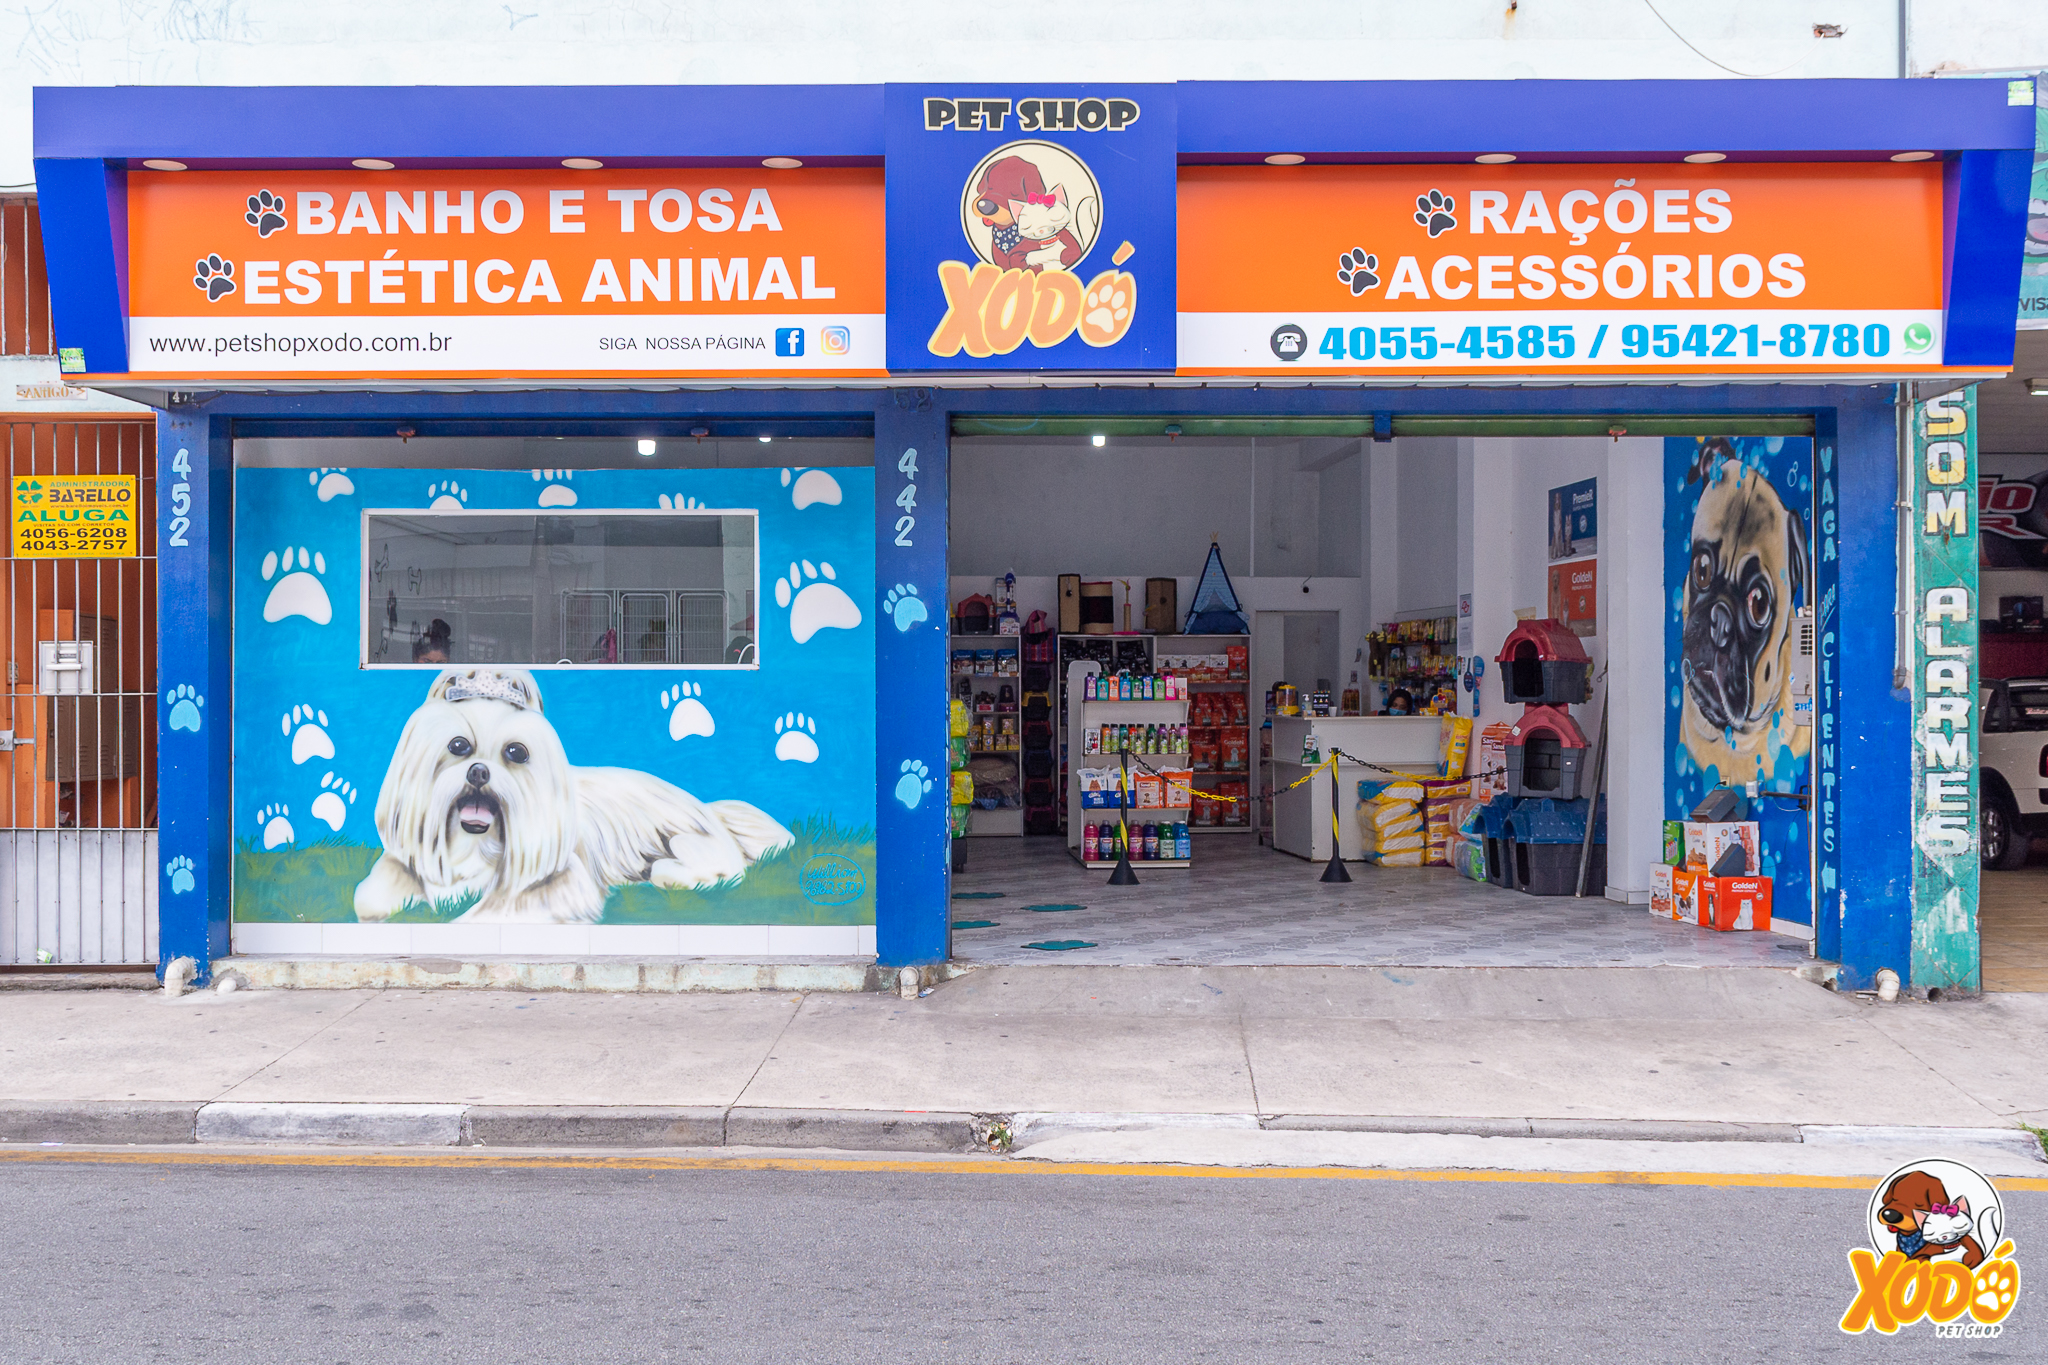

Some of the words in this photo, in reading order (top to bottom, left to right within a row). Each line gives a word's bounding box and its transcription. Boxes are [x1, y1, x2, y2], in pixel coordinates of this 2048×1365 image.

[924, 98, 1010, 131] PET
[1018, 98, 1140, 131] SHOP
[296, 189, 525, 235] BANHO
[549, 189, 586, 234] E
[607, 188, 783, 233] TOSA
[1469, 178, 1733, 246] RAÇÕES
[244, 249, 563, 305] ESTÉTICA
[580, 257, 836, 303] ANIMAL
[1384, 242, 1807, 300] ACESSÓRIOS
[149, 332, 453, 357] www.petshopxodo.com.br
[599, 337, 637, 350] SIGA
[645, 337, 702, 350] NOSSA
[705, 334, 767, 350] PÁGINA
[1318, 325, 1576, 360] 4055-4585
[1621, 324, 1891, 359] 95421-8780
[1924, 389, 1970, 537] SOM
[17, 509, 130, 523] ALUGA
[49, 488, 131, 503] BARELLO
[168, 447, 192, 547] 452
[894, 447, 919, 547] 442
[1819, 446, 1837, 563] VAGA
[20, 528, 128, 538] 4056-6208
[21, 539, 128, 551] 4043-2757
[1821, 631, 1837, 853] CLIENTES
[1923, 586, 1972, 858] ALARMES
